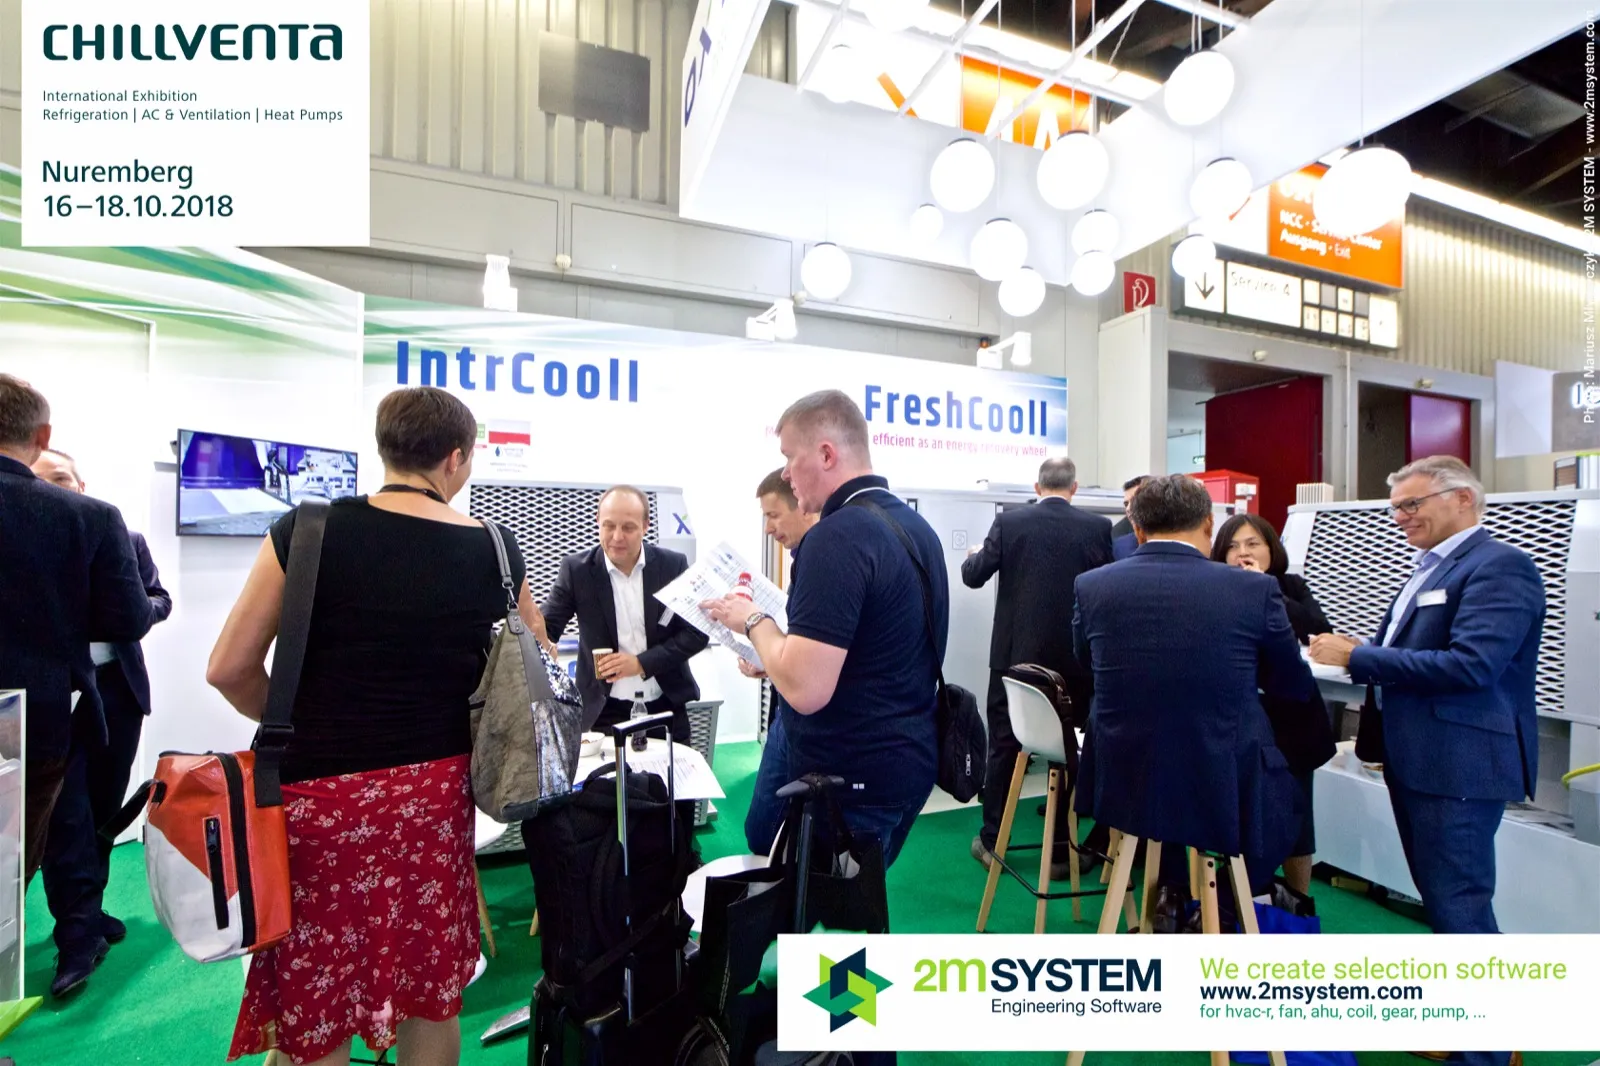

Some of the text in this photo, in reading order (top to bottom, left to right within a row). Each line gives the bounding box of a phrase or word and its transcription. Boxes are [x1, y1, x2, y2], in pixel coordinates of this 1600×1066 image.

[397, 341, 638, 402] IntrCooll
[865, 384, 1047, 437] FreshCooll
[873, 432, 915, 448] efficient
[918, 438, 929, 449] as
[931, 439, 943, 450] an
[946, 440, 977, 454] energy
[1022, 445, 1047, 457] wheel
